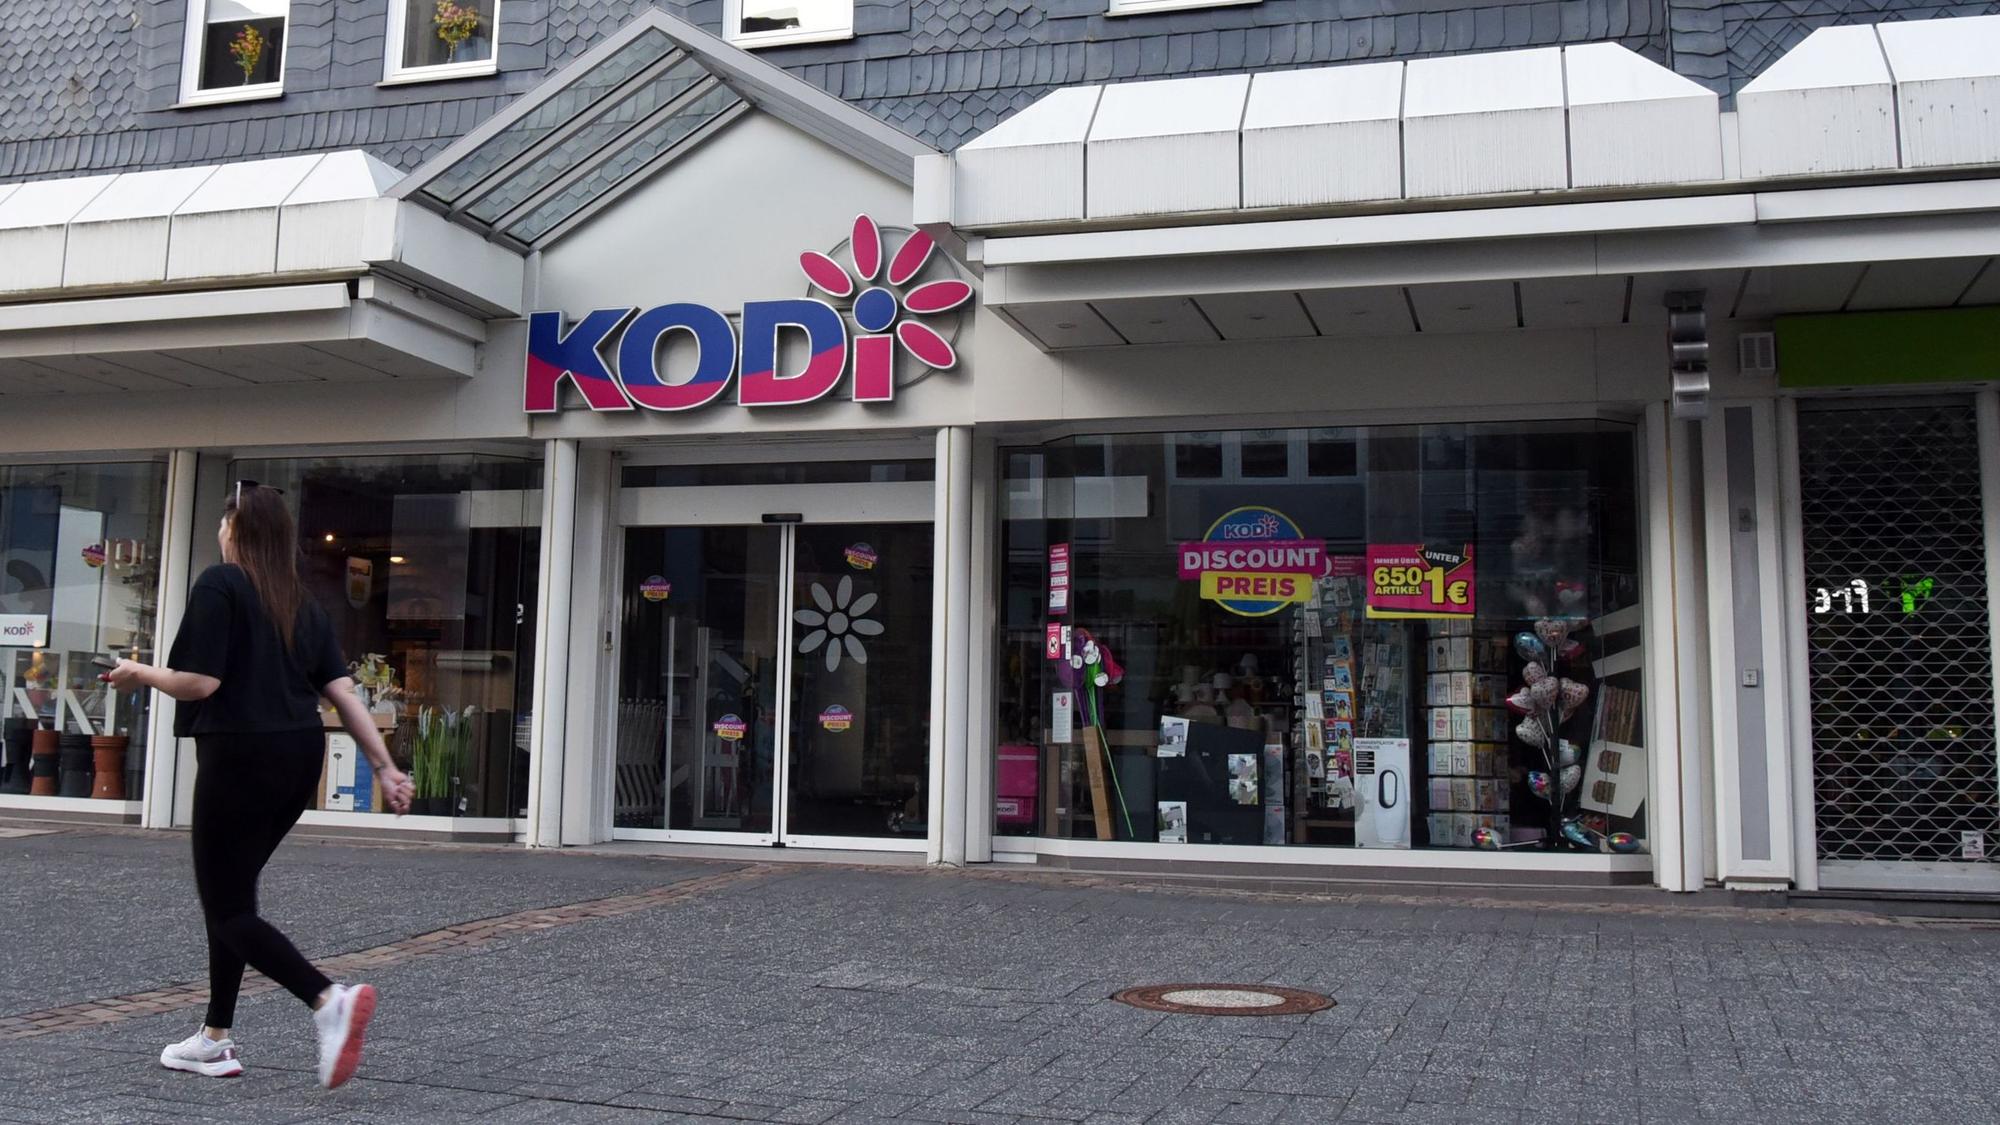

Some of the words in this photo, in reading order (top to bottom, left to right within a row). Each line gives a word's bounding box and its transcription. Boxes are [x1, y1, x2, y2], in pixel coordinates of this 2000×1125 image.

[1183, 547, 1320, 570] DISCOUNT
[1425, 551, 1460, 564] UNTER
[1373, 566, 1423, 586] 650
[1216, 576, 1296, 597] PREIS
[1374, 586, 1422, 595] ARTIKEL
